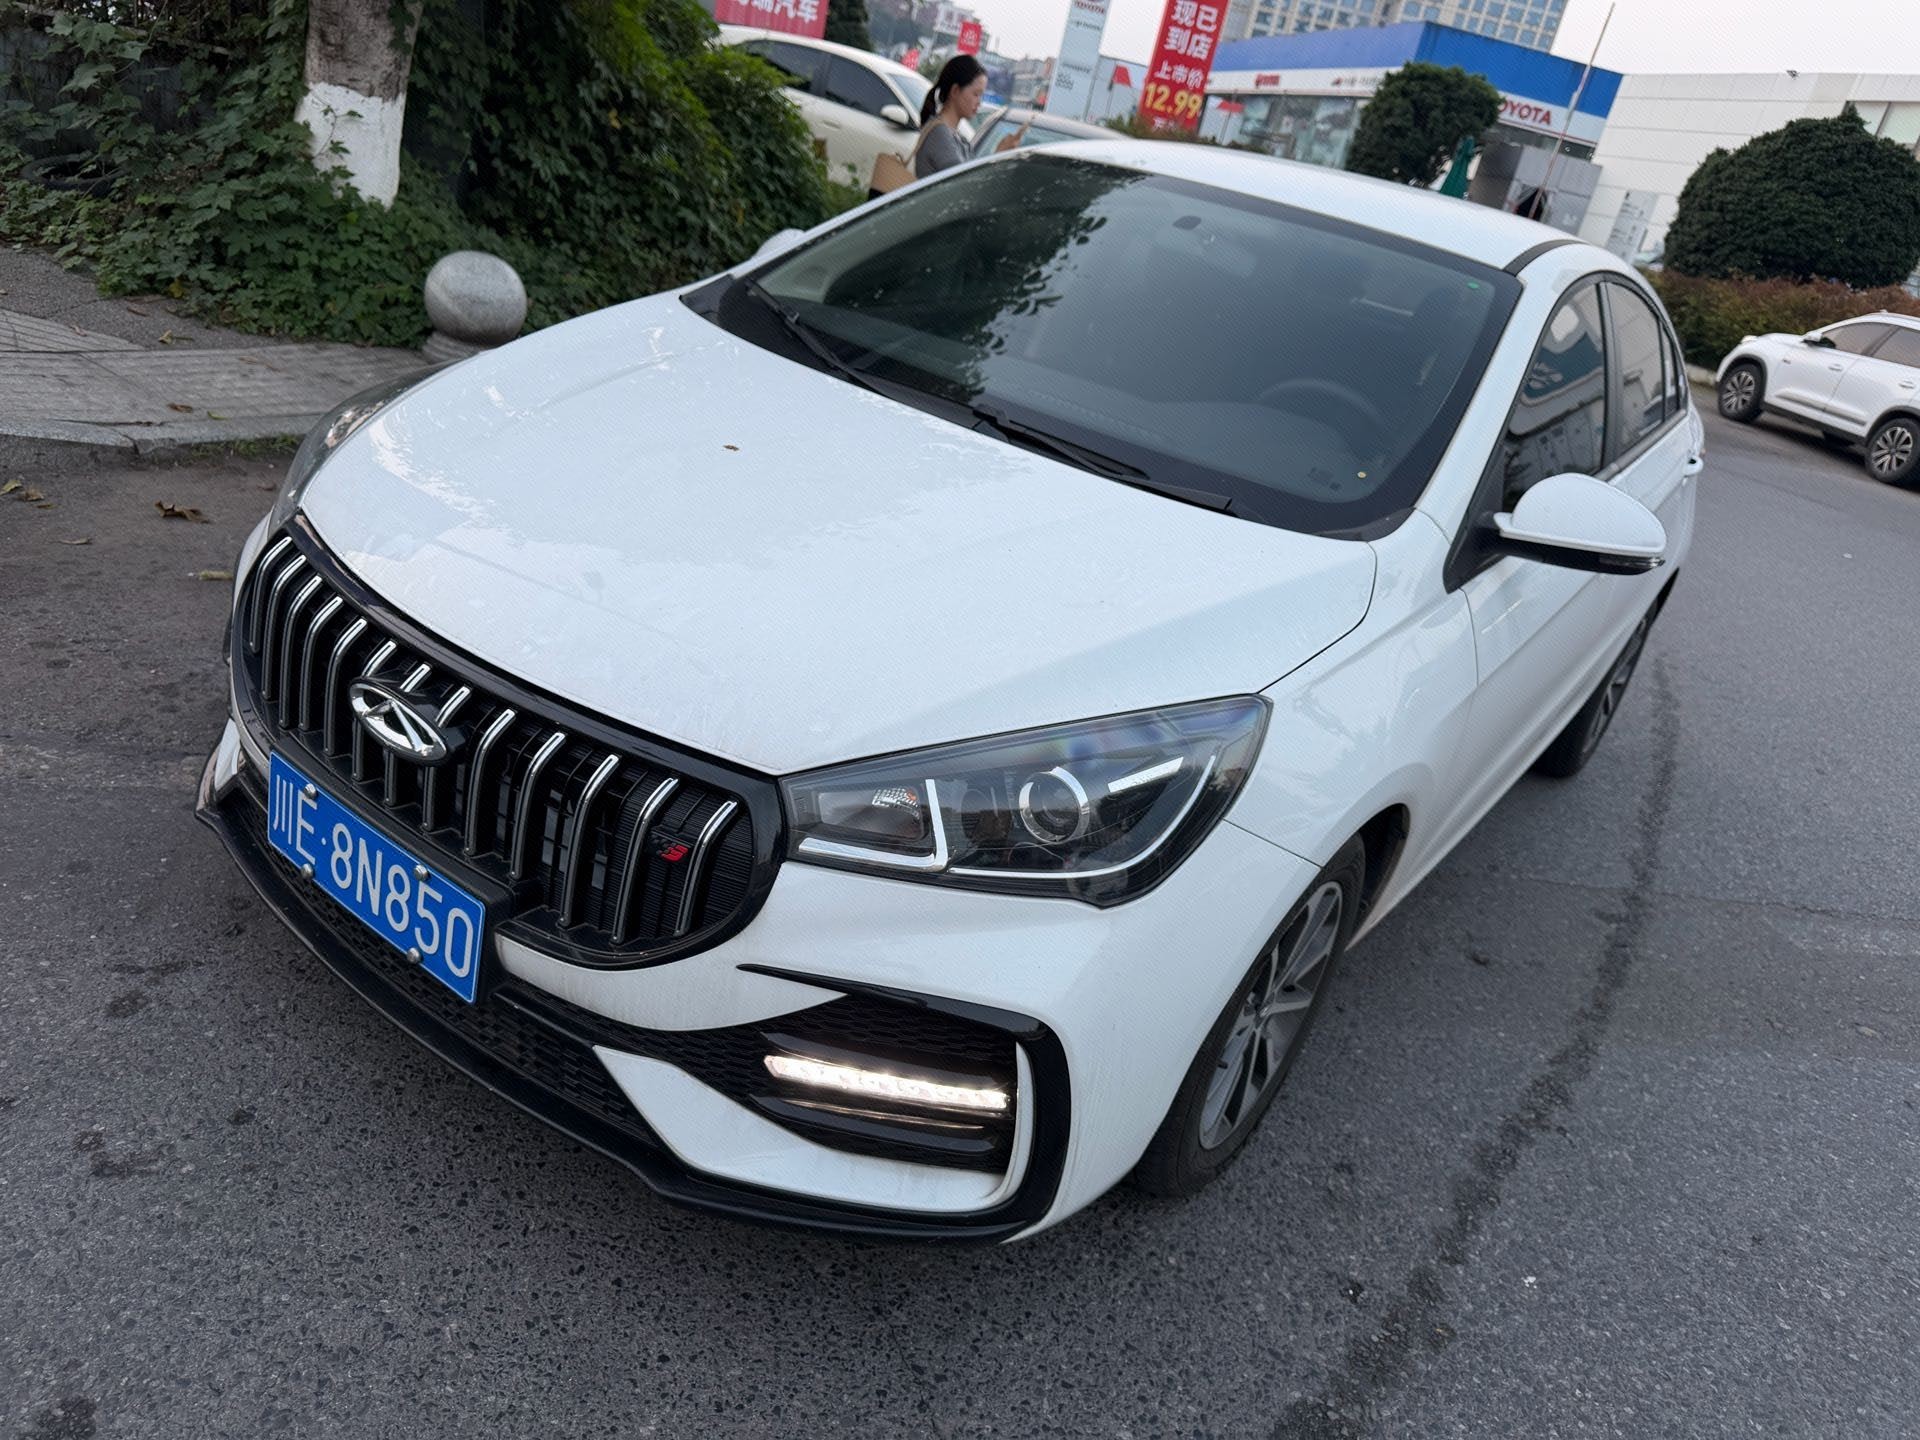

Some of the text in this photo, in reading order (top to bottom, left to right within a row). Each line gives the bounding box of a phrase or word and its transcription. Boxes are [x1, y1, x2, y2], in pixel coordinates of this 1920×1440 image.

[1171, 0, 1218, 33] 现已
[1164, 26, 1213, 60] 到店
[1154, 60, 1204, 90] 上市价
[1145, 82, 1202, 119] 12.99
[1497, 100, 1551, 126] OYOTA
